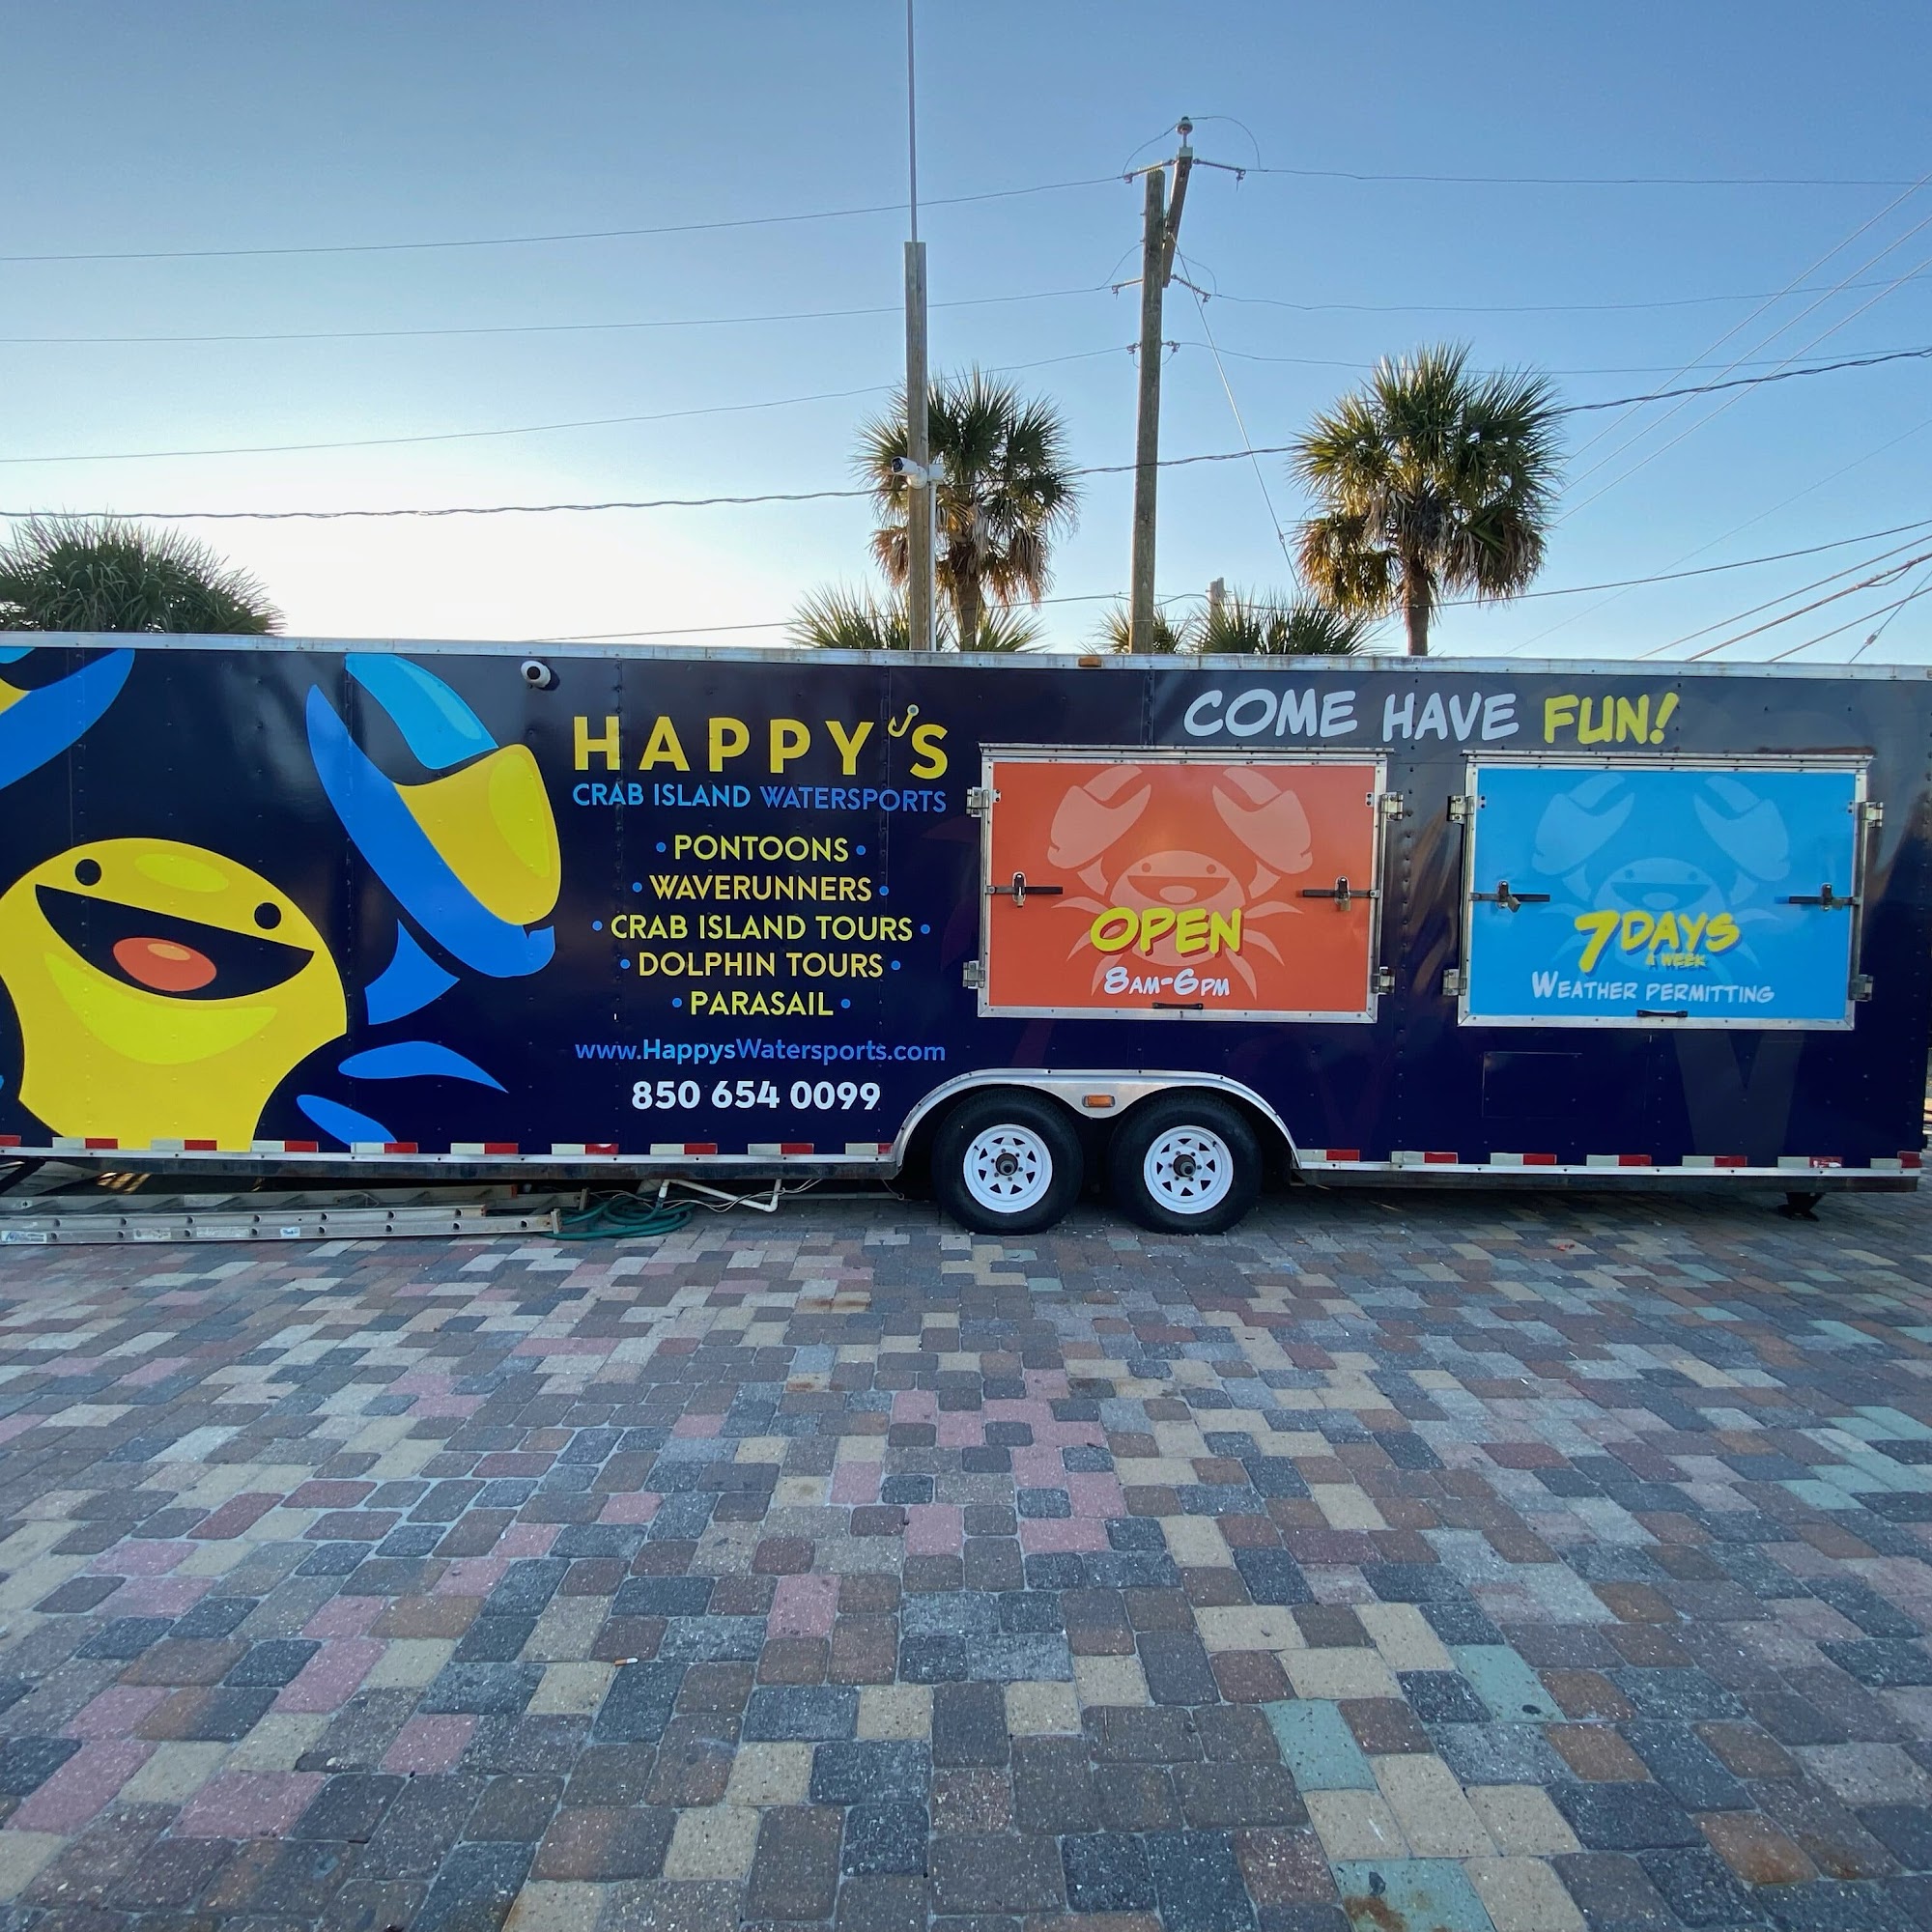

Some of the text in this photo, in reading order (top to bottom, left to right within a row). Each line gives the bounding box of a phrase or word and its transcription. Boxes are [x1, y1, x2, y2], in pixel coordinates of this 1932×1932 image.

[1183, 688, 1679, 744] COME HAVE FUN!
[572, 782, 947, 813] CRAB ISLAND WATERSPORTS
[674, 835, 849, 863] PONTOONS
[649, 874, 872, 902] WAVERUNNERS
[611, 914, 913, 942] CRAB ISLAND TOURS
[1090, 906, 1243, 956] OPEN
[639, 952, 883, 978] DOLPHIN TOURS
[1661, 952, 1709, 969] WEEK
[691, 990, 834, 1016] PARASAIL
[575, 1038, 946, 1065] www.HappysWatersports.com
[631, 1080, 881, 1111] 850 654 0099
